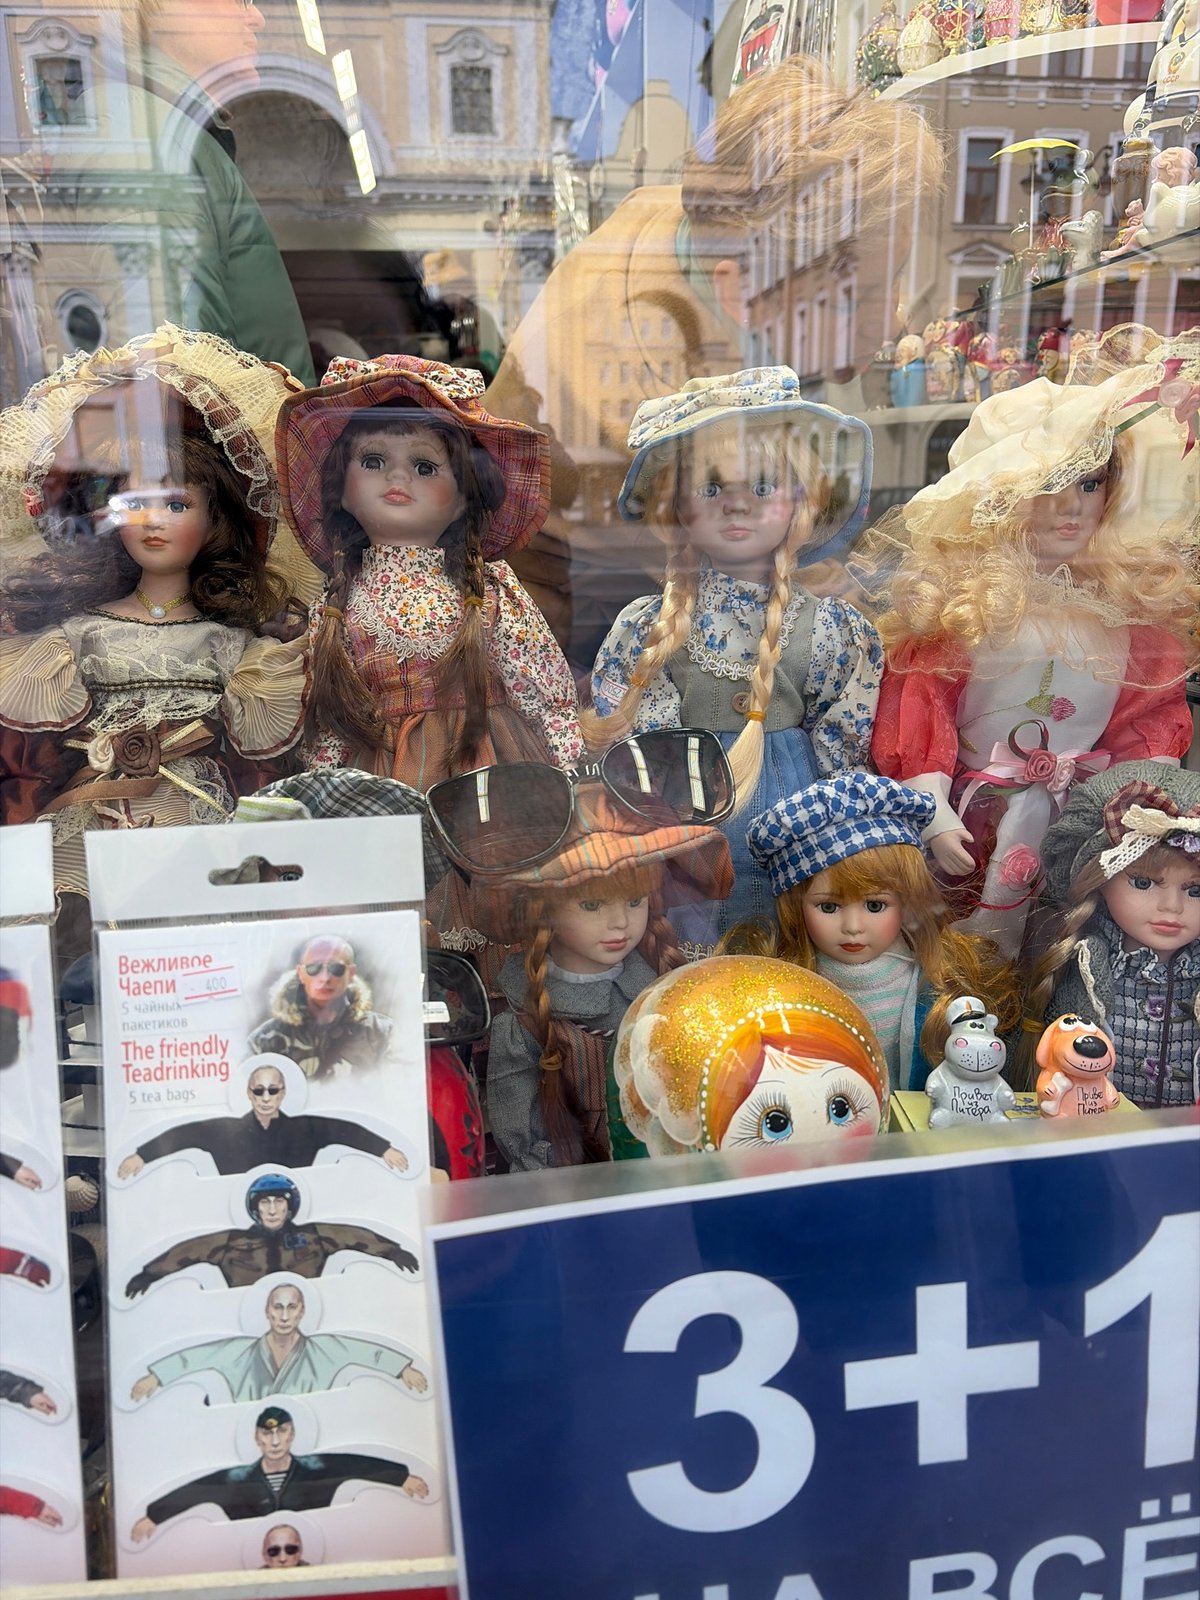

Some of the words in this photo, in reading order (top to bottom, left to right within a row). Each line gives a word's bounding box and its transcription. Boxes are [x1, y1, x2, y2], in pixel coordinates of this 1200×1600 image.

[118, 954, 213, 975] Вежливое
[119, 977, 176, 997] Чаепи
[206, 976, 227, 992] 400
[121, 1001, 130, 1015] 5
[134, 1000, 182, 1014] чайных
[122, 1017, 188, 1032] пакетиков
[121, 1040, 154, 1061] The
[160, 1033, 229, 1060] friendly
[121, 1058, 229, 1083] Teadrinking
[129, 1090, 137, 1104] 5
[141, 1090, 161, 1103] tea
[166, 1087, 196, 1103] bags
[953, 1085, 993, 1106] Привет
[951, 1097, 991, 1121] Питера
